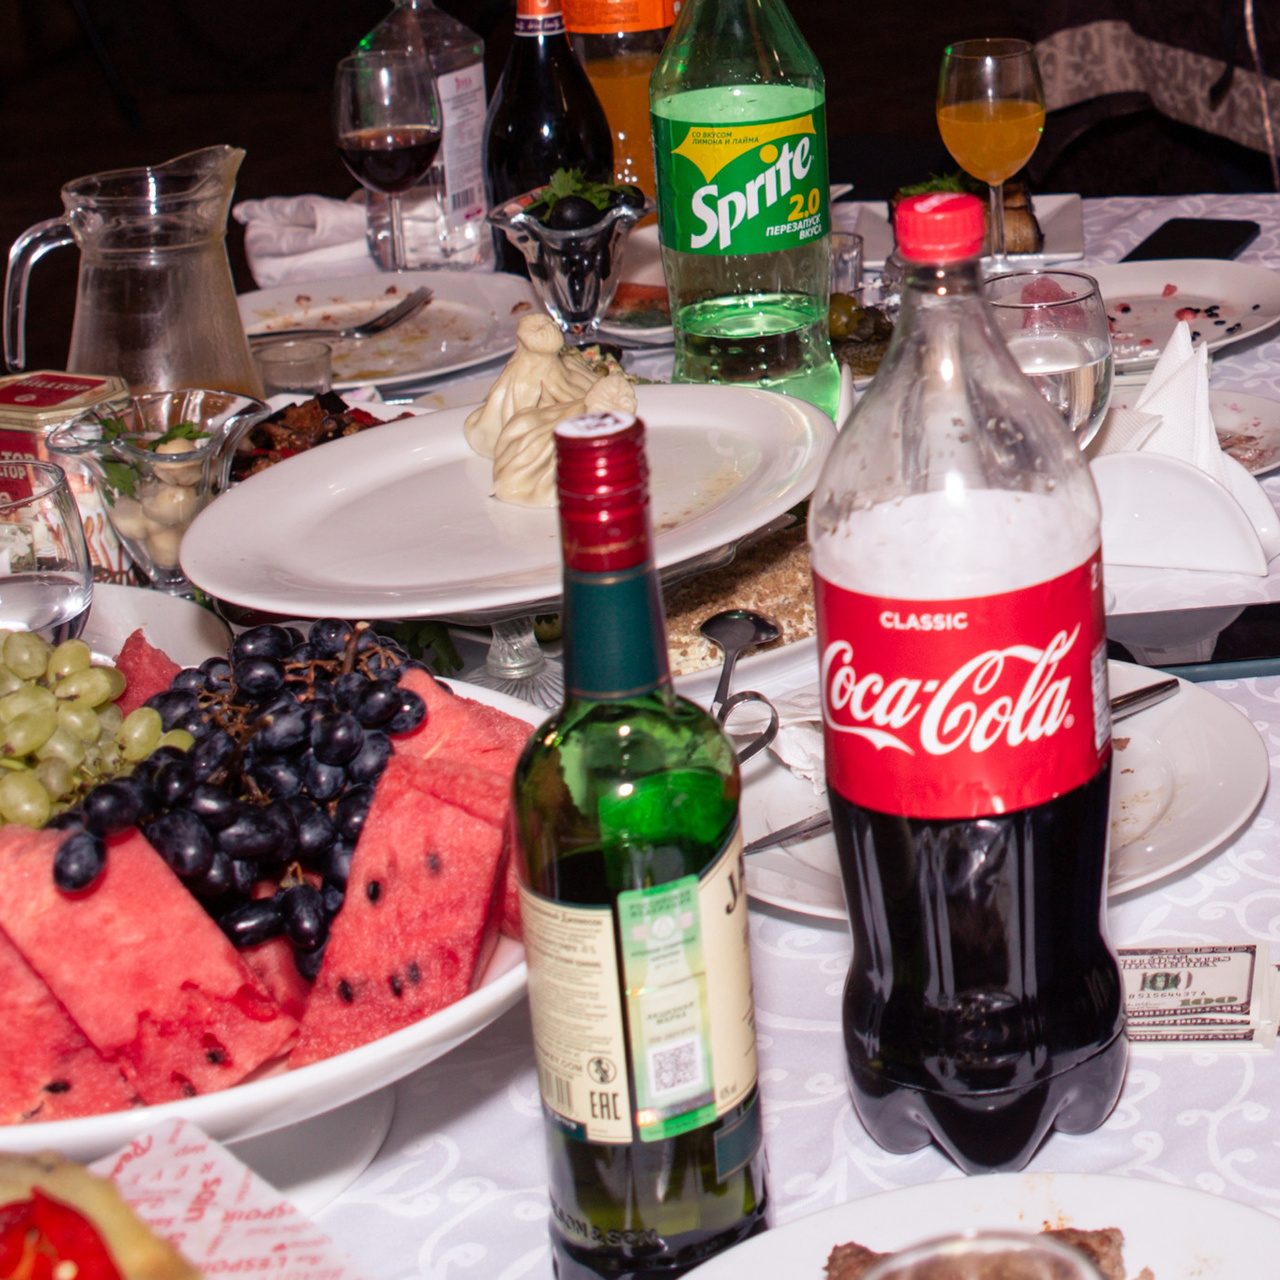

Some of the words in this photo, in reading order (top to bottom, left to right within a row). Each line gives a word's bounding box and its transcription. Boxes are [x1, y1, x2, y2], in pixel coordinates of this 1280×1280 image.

[691, 138, 723, 146] ЛИМОНА
[691, 136, 813, 251] Sprite
[787, 187, 821, 223] 2.0
[765, 214, 822, 237] ПЕРЕЗАПУСК
[16, 380, 91, 392] HILLTOP
[879, 611, 969, 631] CLASSIC
[821, 622, 1082, 757] Coca-Cola
[1180, 995, 1239, 1007] 100
